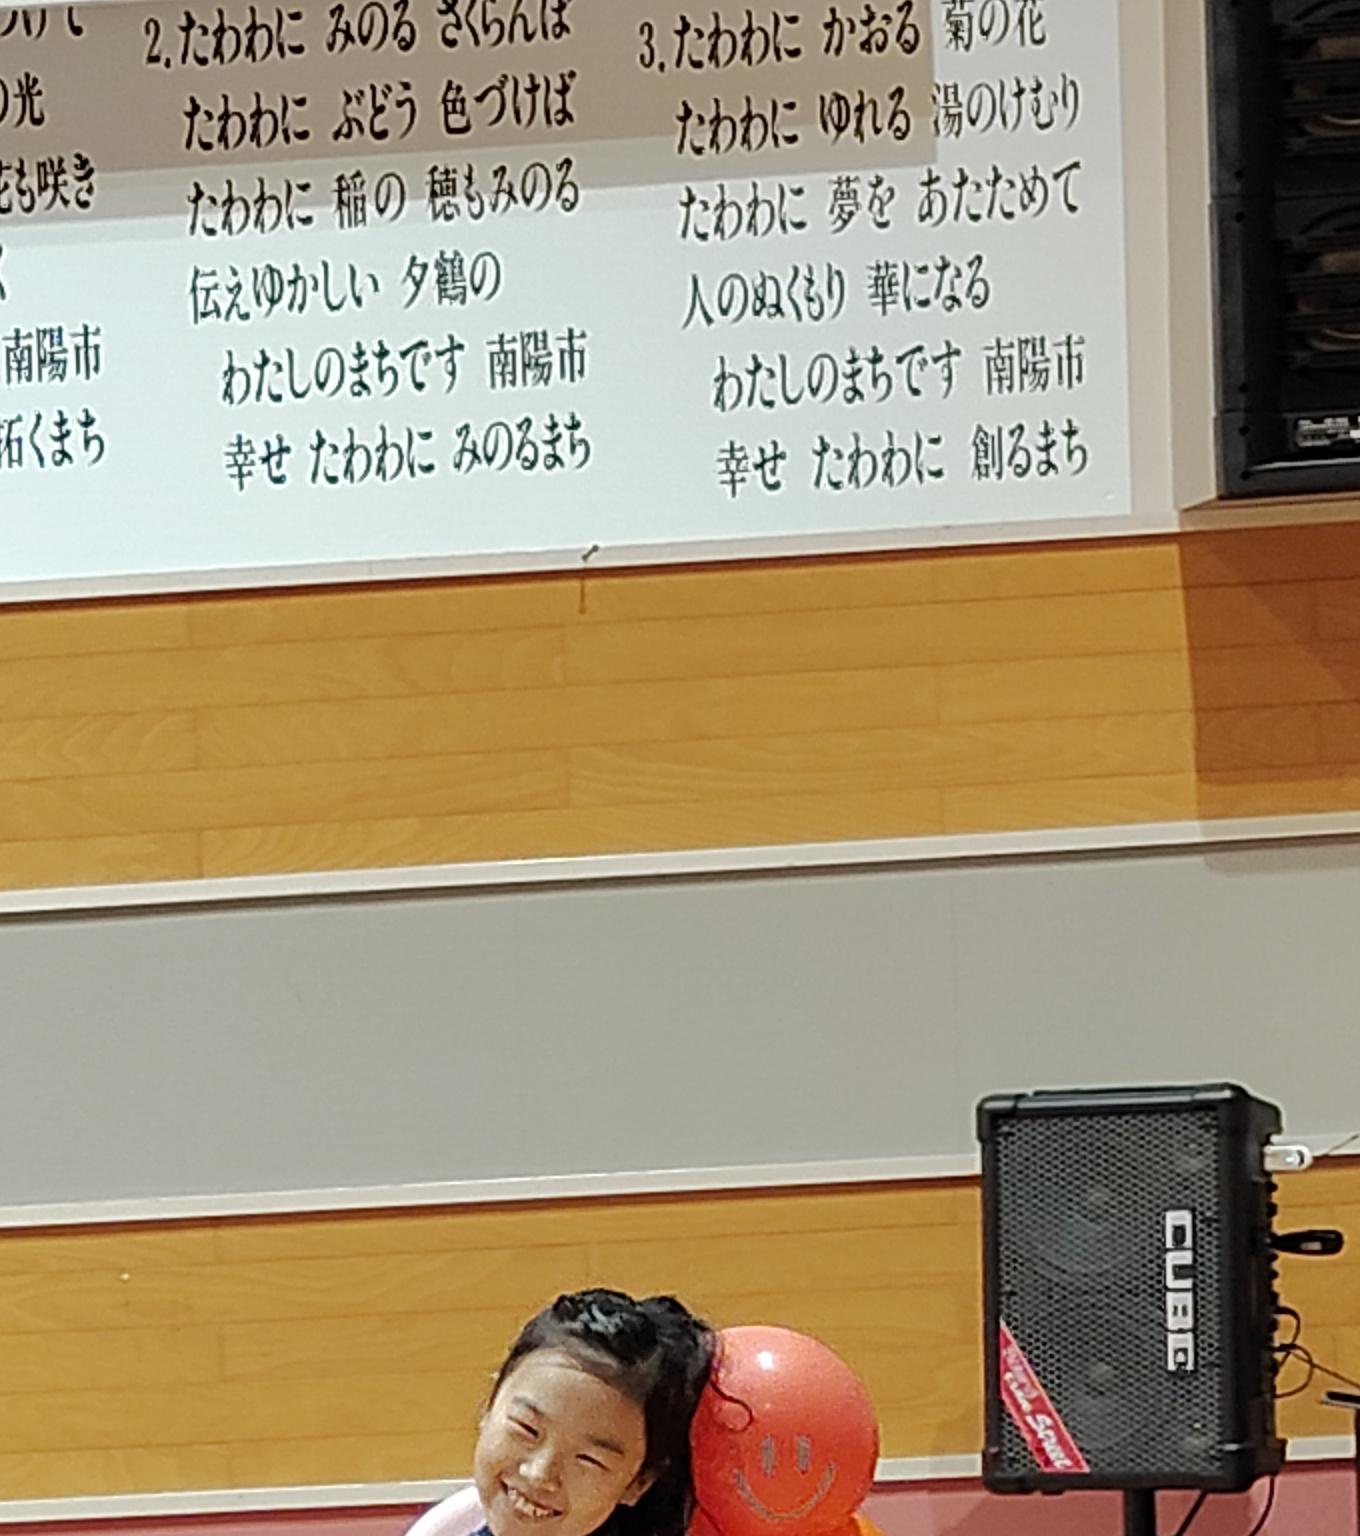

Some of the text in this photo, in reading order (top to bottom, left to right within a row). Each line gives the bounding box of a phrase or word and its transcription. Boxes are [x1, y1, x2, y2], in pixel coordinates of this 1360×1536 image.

[144, 5, 305, 70] 2.たわわに
[326, 0, 417, 54] みのる
[639, 0, 1046, 73] 3.たわわに かおる 菊の花
[183, 91, 311, 152] たわわに
[675, 71, 1080, 157] たわわに ゆれる 湯のけむり
[186, 157, 580, 237] たわわに 稲の 穂もみのる
[678, 160, 1082, 242] たわわに 夢を あたためて
[189, 259, 380, 325] 伝えゆかしい
[682, 253, 990, 330] 人のぬくもり 華になる
[1, 323, 101, 386] 南陽市
[221, 326, 588, 406] わたしのまちです 南陽市
[713, 333, 1086, 413] わたしのまちです 南陽市
[223, 411, 591, 492] 幸せ たわわに みのるまち
[716, 417, 1088, 499] 幸せ たわわに 創るまち
